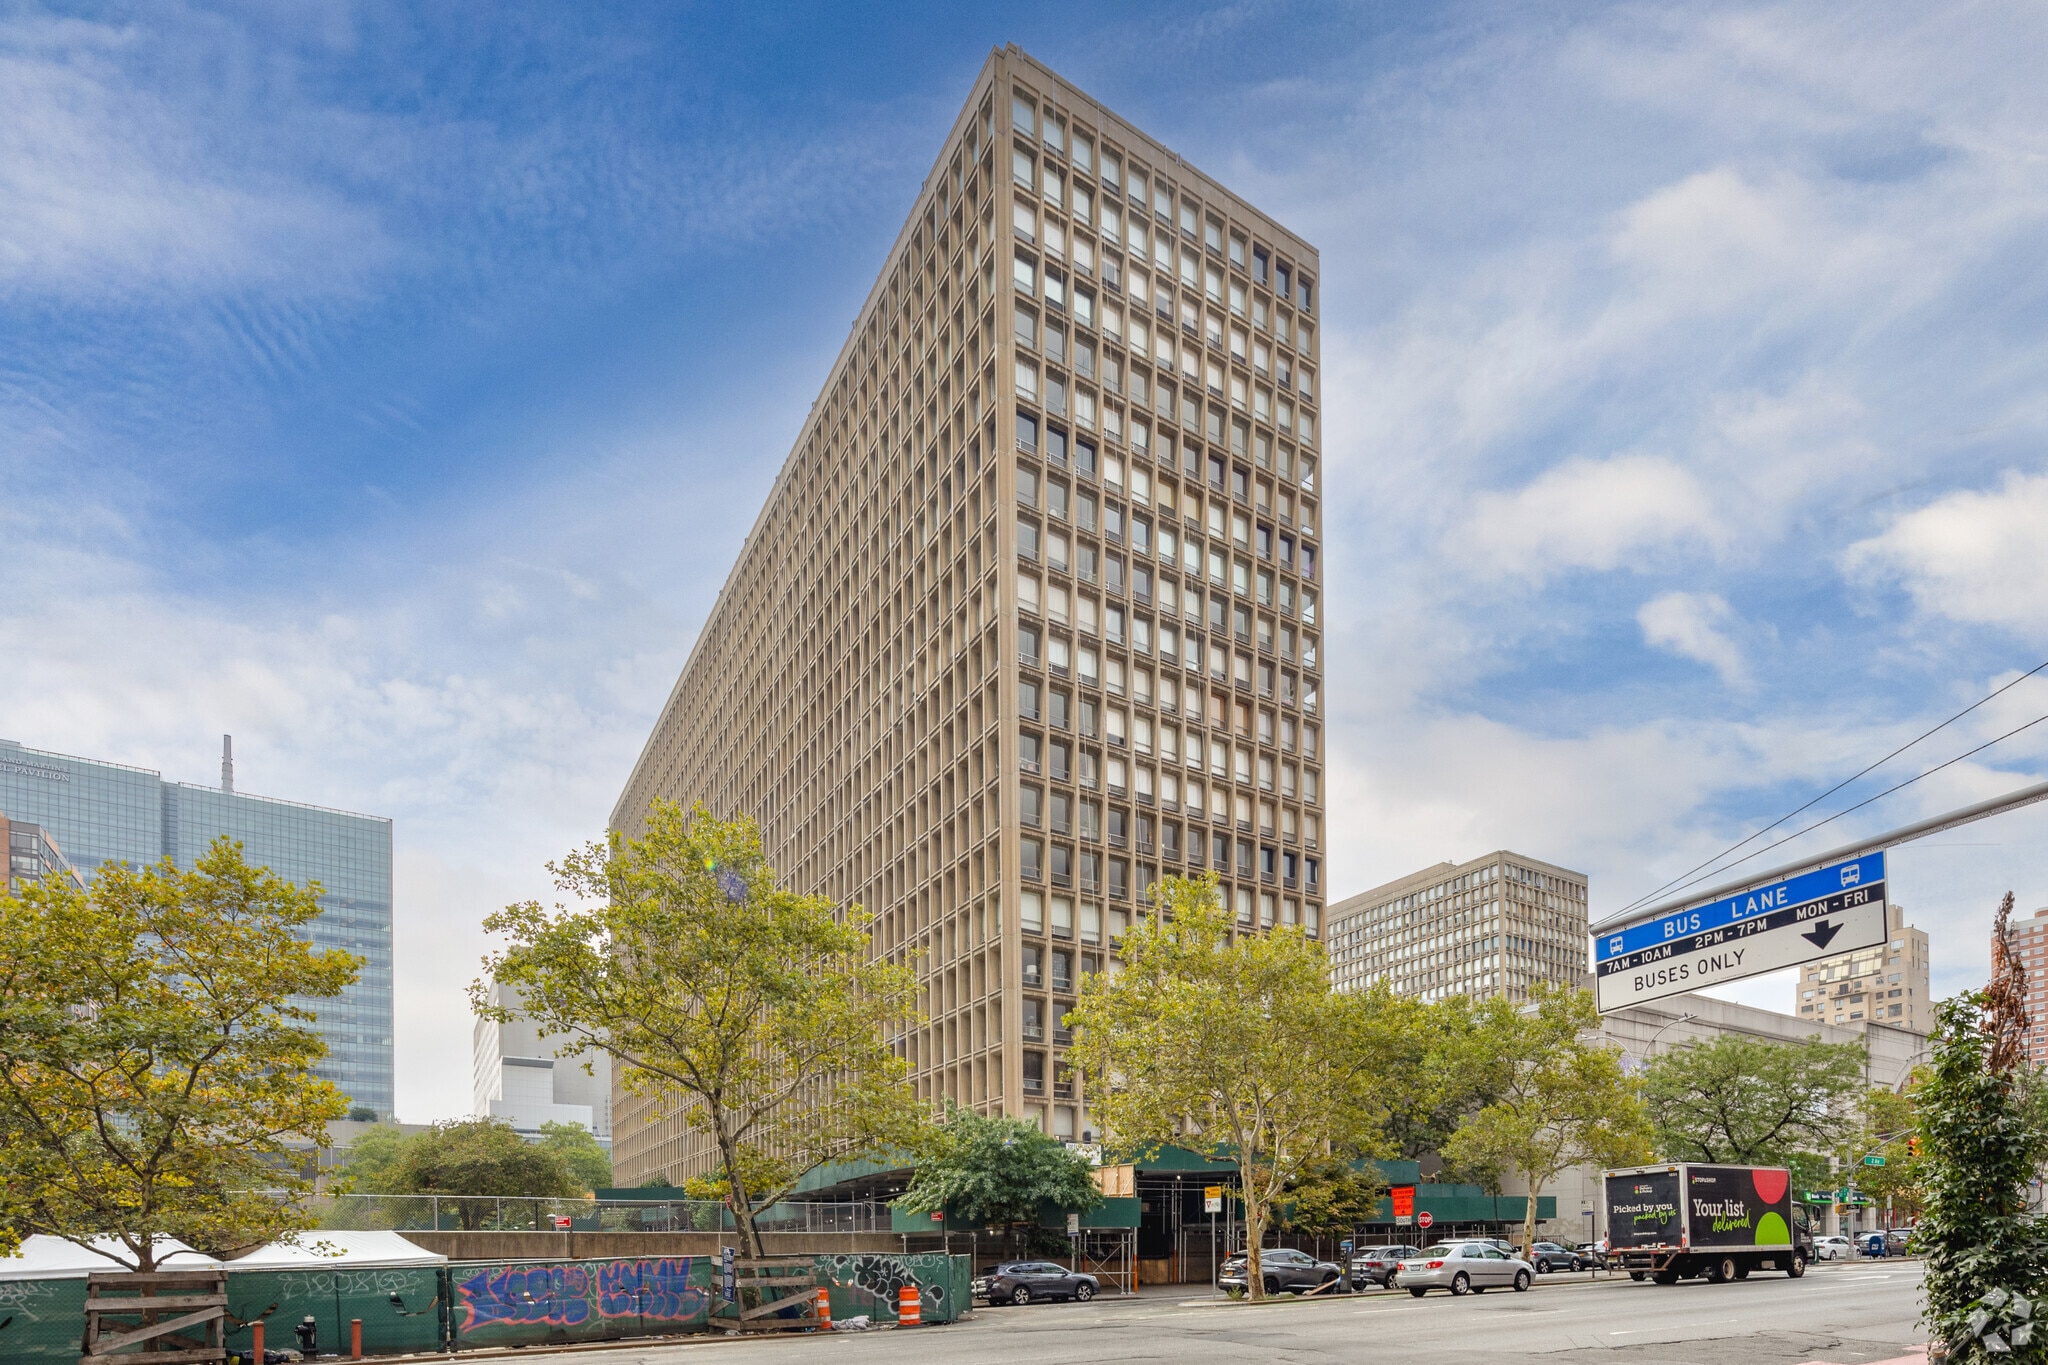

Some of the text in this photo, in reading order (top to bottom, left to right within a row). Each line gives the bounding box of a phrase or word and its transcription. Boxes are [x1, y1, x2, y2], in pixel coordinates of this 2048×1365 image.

[2, 757, 22, 765] AND
[14, 766, 70, 782] PAVILION
[1663, 886, 1788, 939] BUS LANE
[1606, 958, 1630, 974] 7AM
[1640, 945, 1672, 964] 10AM
[1695, 932, 1723, 949] 2PM
[1737, 918, 1767, 938] 7PM
[1796, 901, 1828, 921] MON
[1844, 890, 1869, 908] FRI
[1634, 966, 1689, 991] BUSES
[1697, 948, 1745, 975] ONLY
[1613, 1203, 1673, 1213] Picked by you
[1693, 1198, 1744, 1217] Your list
[1418, 1216, 1432, 1224] STOP
[1633, 1209, 1657, 1226] packed
[1658, 1208, 1668, 1225] by
[1712, 1210, 1751, 1233] delivered
